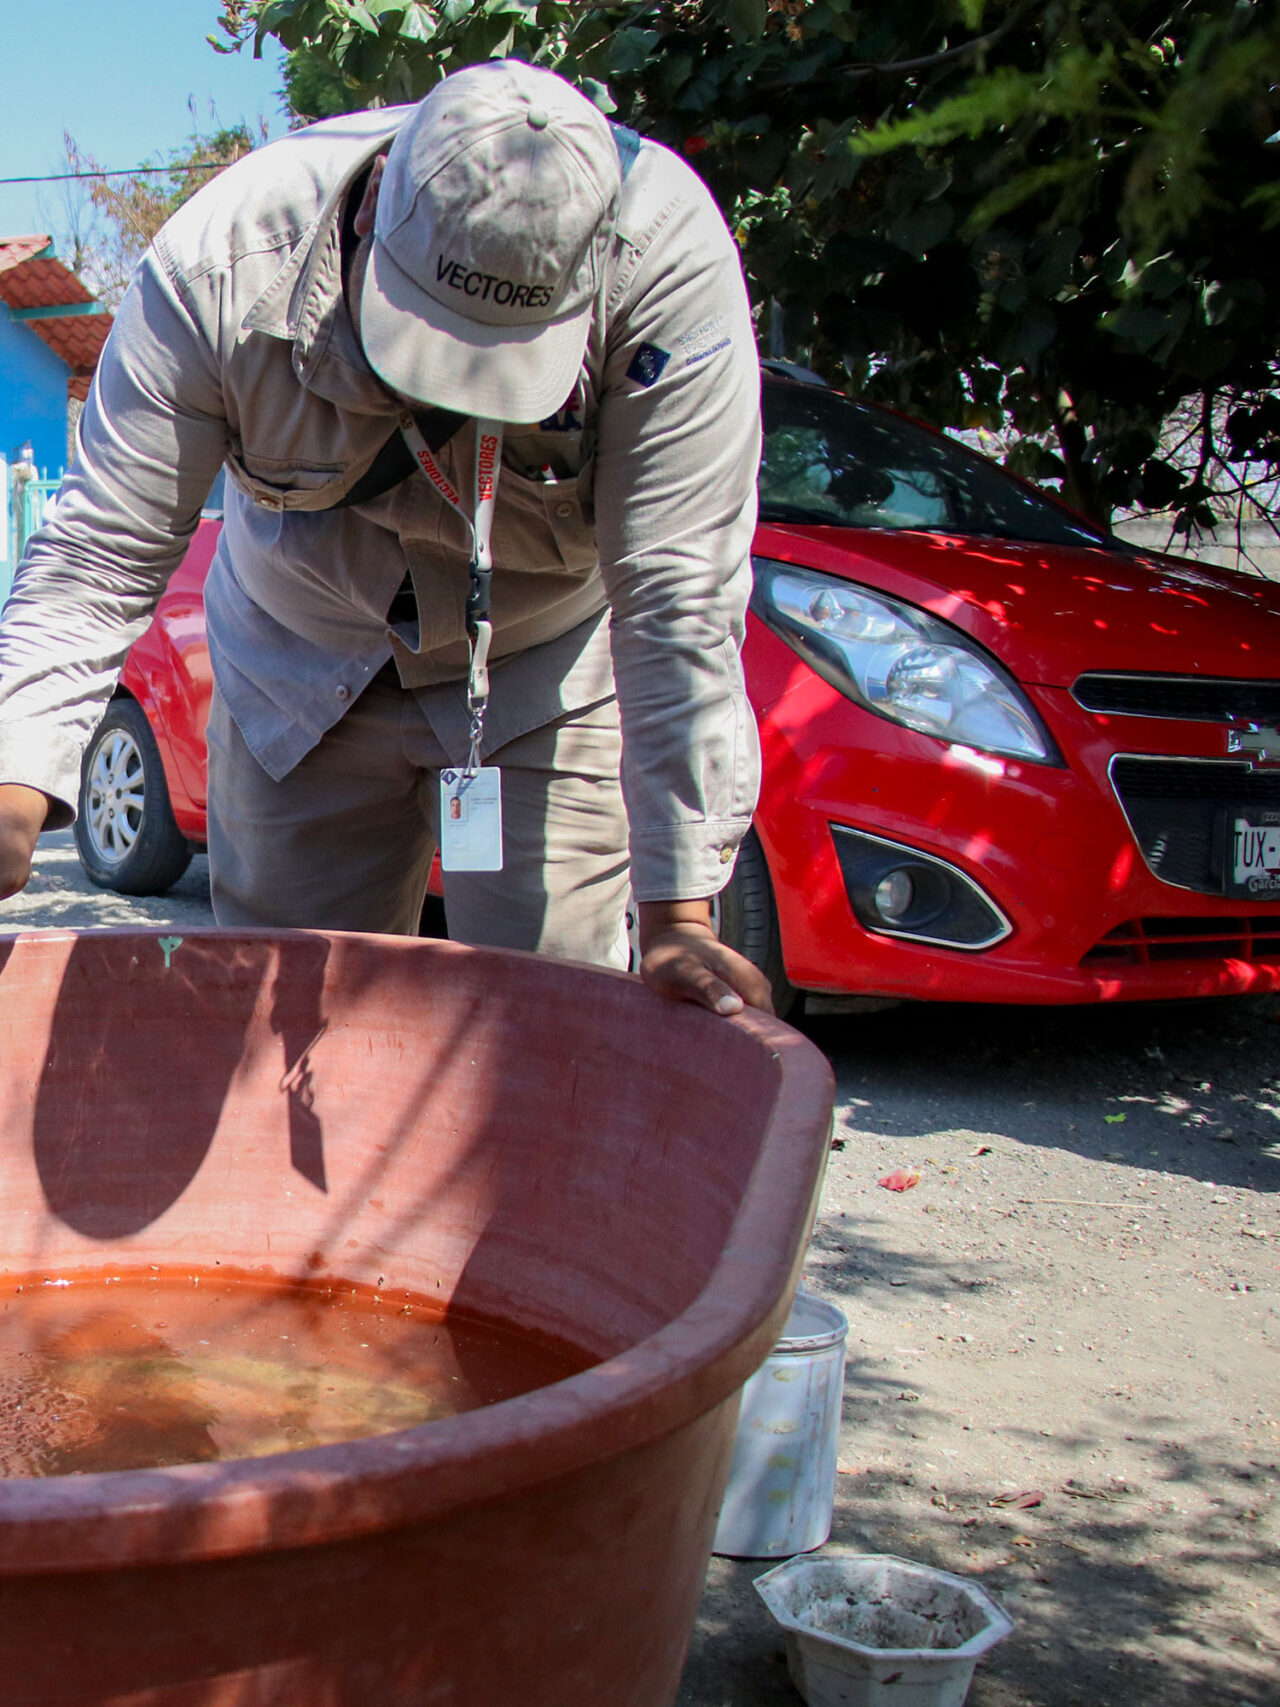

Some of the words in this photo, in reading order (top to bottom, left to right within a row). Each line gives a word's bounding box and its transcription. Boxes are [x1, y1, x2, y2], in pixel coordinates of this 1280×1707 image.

[437, 254, 554, 307] VECTORES
[417, 450, 460, 505] VECTORES
[478, 434, 499, 502] VECTORES
[1234, 831, 1280, 868] TUX-
